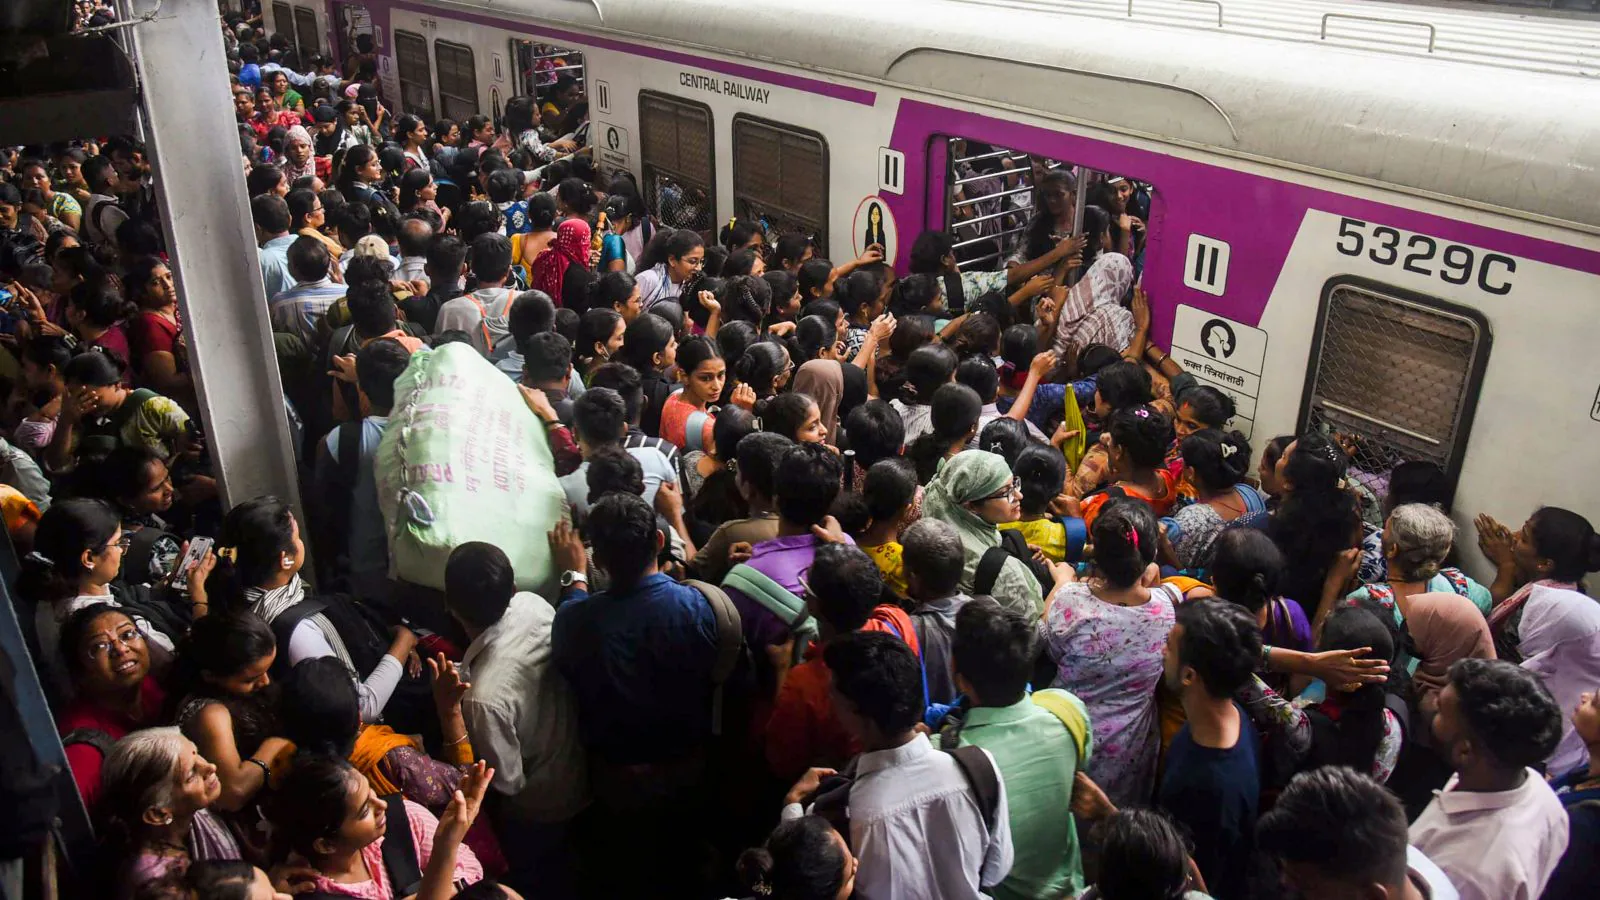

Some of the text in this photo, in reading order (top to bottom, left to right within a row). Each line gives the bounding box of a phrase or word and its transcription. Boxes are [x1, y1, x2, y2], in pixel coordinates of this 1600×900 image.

[680, 72, 770, 104] CENTRAL RAILWAY
[1336, 217, 1516, 295] 5329C
[1183, 358, 1245, 388] फक्त स्त्रियांसाठी
